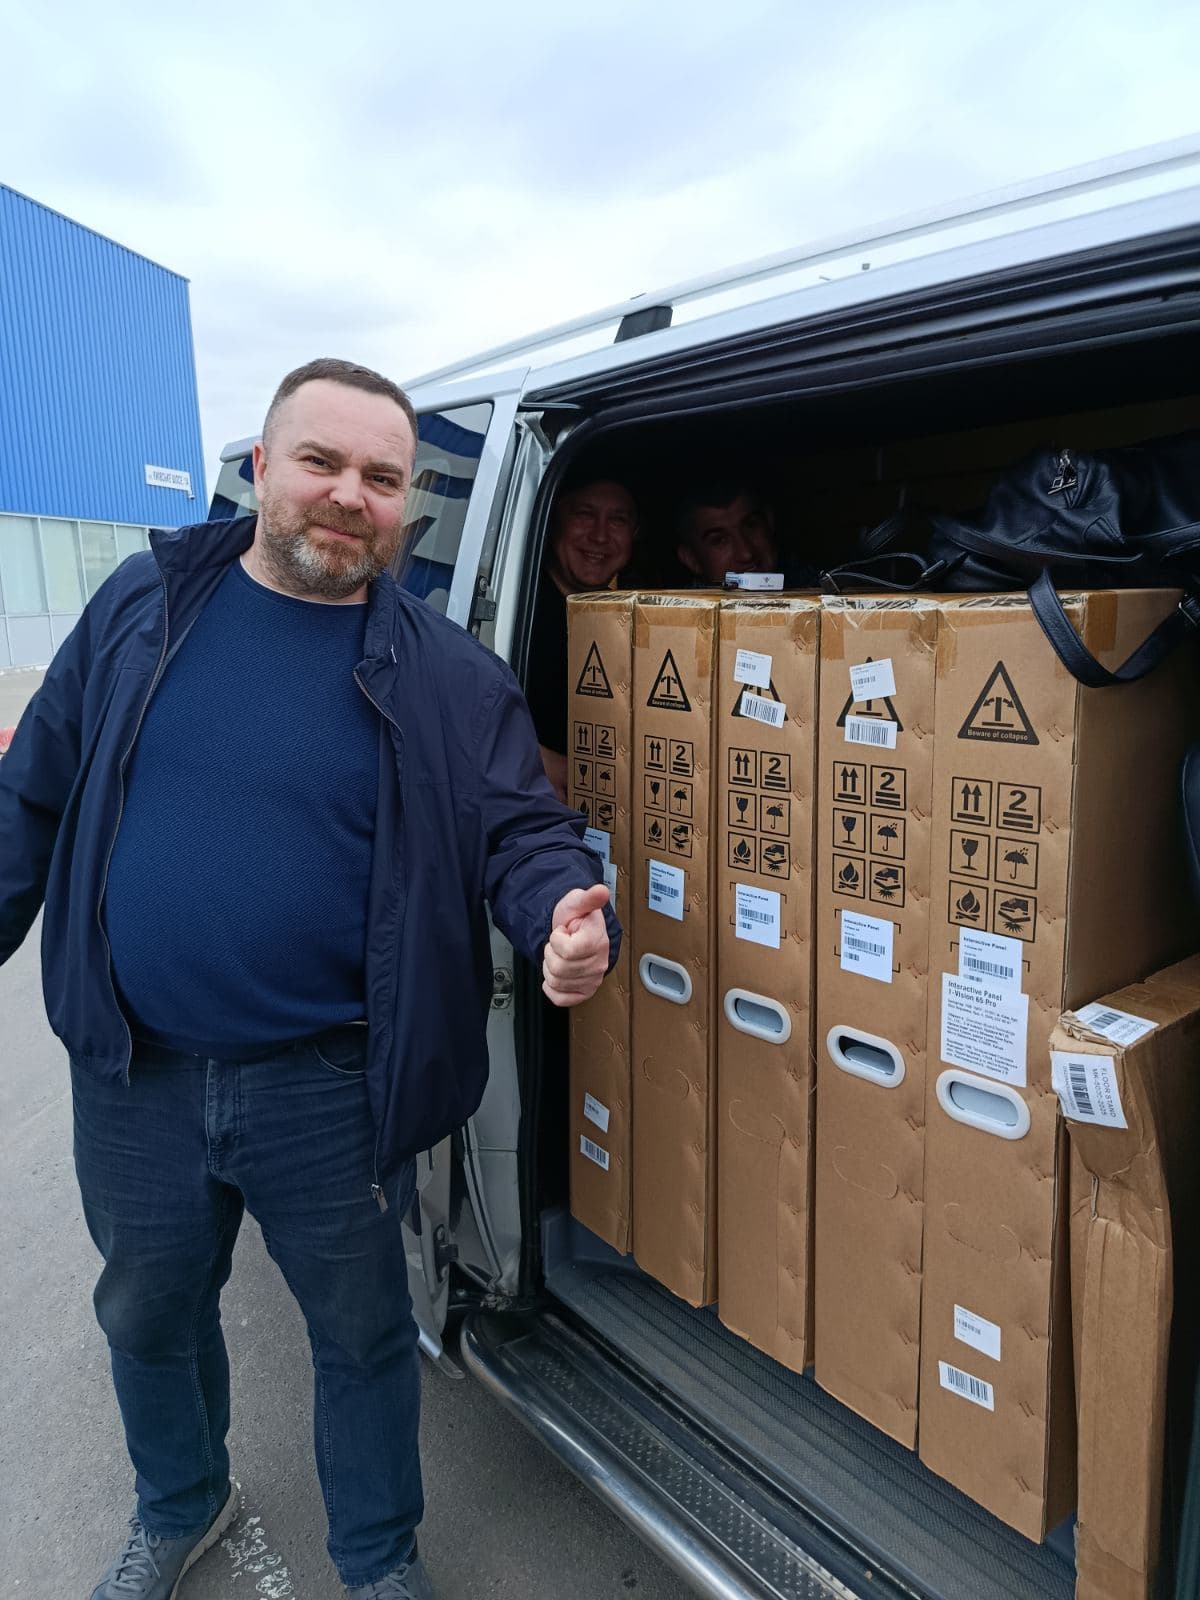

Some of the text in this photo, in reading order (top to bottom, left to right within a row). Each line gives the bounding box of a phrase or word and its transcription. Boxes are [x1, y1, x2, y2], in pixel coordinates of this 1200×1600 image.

[600, 729, 610, 744] 2
[967, 729, 991, 738] Beware
[1000, 732, 1028, 741] collapse
[675, 745, 686, 761] 2
[768, 757, 781, 775] 2
[879, 772, 895, 791] 2
[1008, 789, 1027, 812] 2
[948, 980, 1002, 1001] Interactive Panel
[976, 996, 984, 1004] 65
[985, 998, 997, 1007] Pro
[1100, 1067, 1117, 1118] FLOOR STAND
